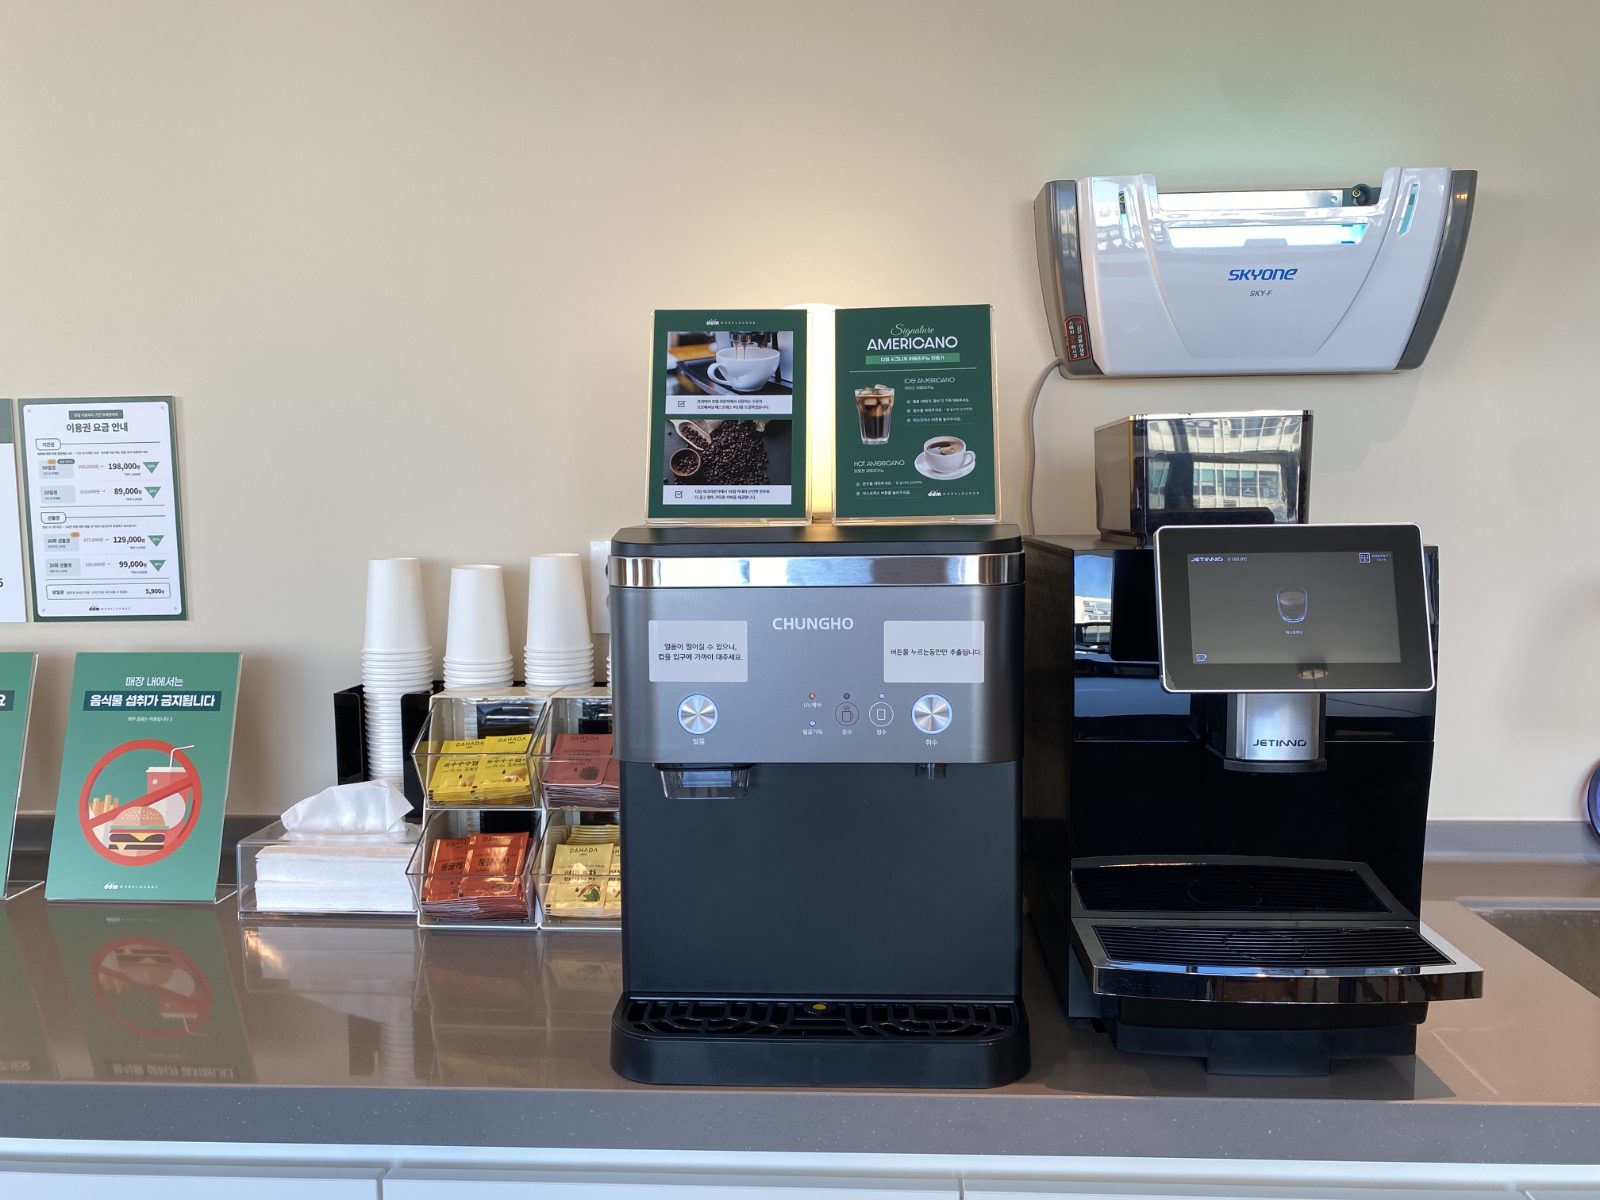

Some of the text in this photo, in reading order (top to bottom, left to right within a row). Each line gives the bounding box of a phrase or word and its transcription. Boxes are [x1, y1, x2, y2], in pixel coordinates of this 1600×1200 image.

[890, 323, 934, 338] Signature
[866, 336, 958, 351] AMERICANO
[66, 422, 129, 433] 이용권 요금 안내
[108, 462, 140, 471] 198,000원
[853, 459, 905, 468] HOT AMERICANO
[114, 487, 142, 496] 89,000원
[113, 536, 146, 545] 129,000원
[119, 561, 148, 569] 99,000원
[772, 617, 854, 631] CHUNGHO
[664, 643, 737, 652] 얼음이 떨어질 수 있으니,
[890, 648, 909, 656] 버튼을
[950, 648, 983, 656] 추출됩니다.
[658, 653, 744, 661] 컵을 입구에 가까이 대주세요.
[125, 676, 185, 687] 매장 내에서는
[90, 694, 216, 707] 음식물 섭취가 금지됩니다
[841, 728, 853, 736] 온수
[692, 737, 705, 745] 얼음
[924, 738, 938, 746] 취수
[1252, 739, 1307, 748] JETINNO
